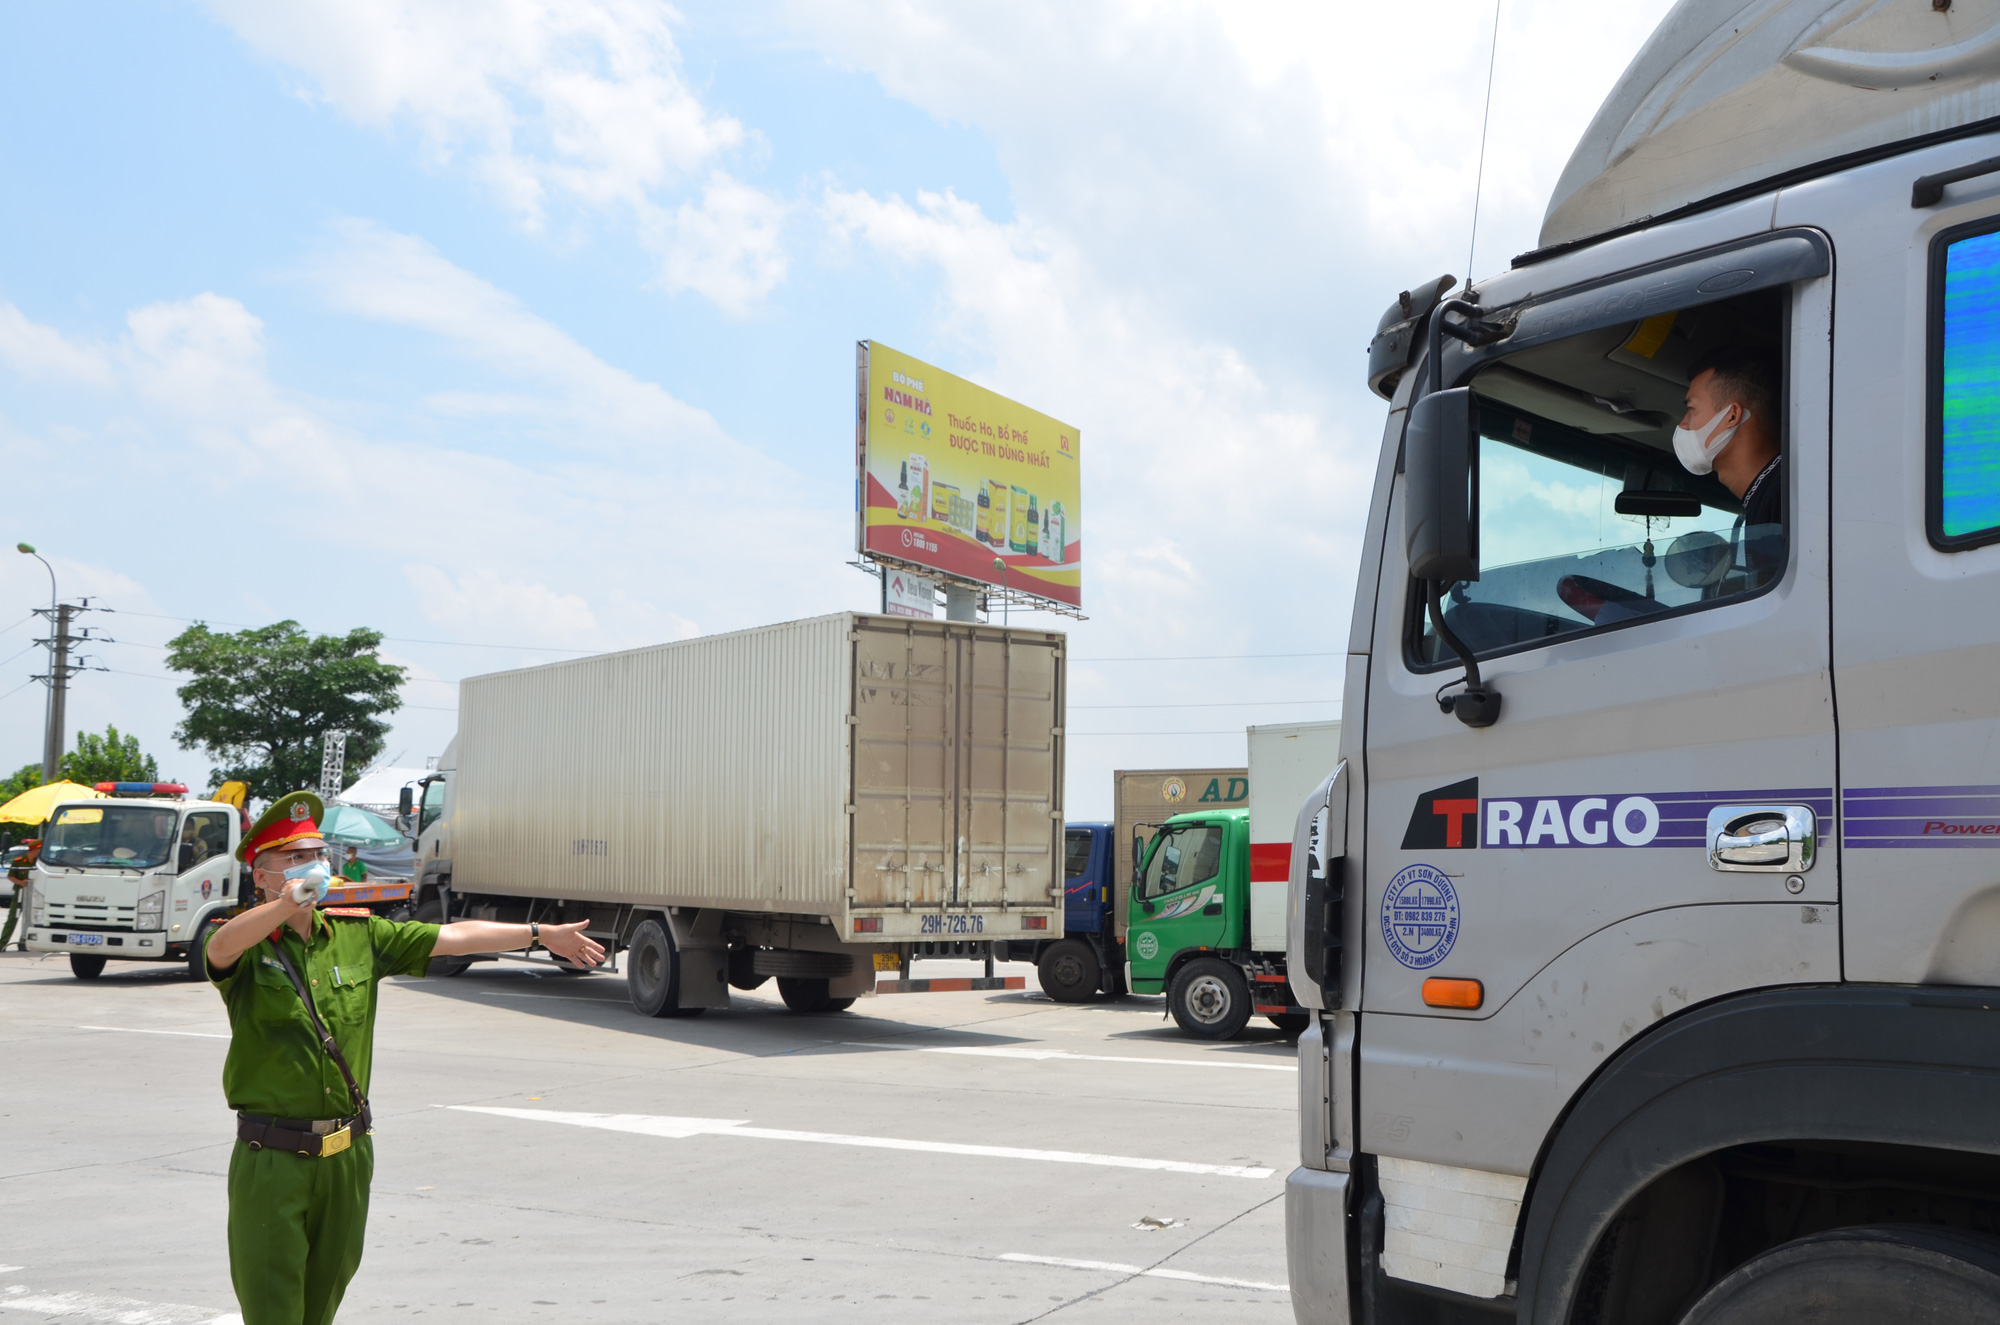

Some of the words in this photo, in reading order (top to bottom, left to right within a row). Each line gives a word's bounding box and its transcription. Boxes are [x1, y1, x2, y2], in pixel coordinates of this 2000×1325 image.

[884, 386, 913, 409] NAM
[948, 413, 977, 433] Thuốc
[997, 424, 1010, 441] Bổ
[1012, 430, 1028, 445] Phế
[949, 434, 979, 455] ĐƯỢC
[981, 441, 996, 457] TIN
[998, 443, 1025, 463] DÙNG
[1027, 450, 1050, 469] NHẤT
[381, 887, 405, 898] GIAO
[1387, 884, 1398, 901] CTY
[1397, 875, 1406, 887] CP
[1407, 869, 1416, 880] VT
[1418, 868, 1433, 880] SƠN
[1433, 875, 1453, 902] DƯƠNG
[921, 915, 983, 933] 29H-726.76
[1394, 911, 1404, 921] ĐT:
[1404, 911, 1420, 921] 0982
[1421, 911, 1433, 921] 839
[1434, 911, 1446, 922] 276
[1402, 927, 1414, 937] 2.N
[1409, 955, 1414, 965] 3
[1414, 954, 1436, 966] HOÀNG
